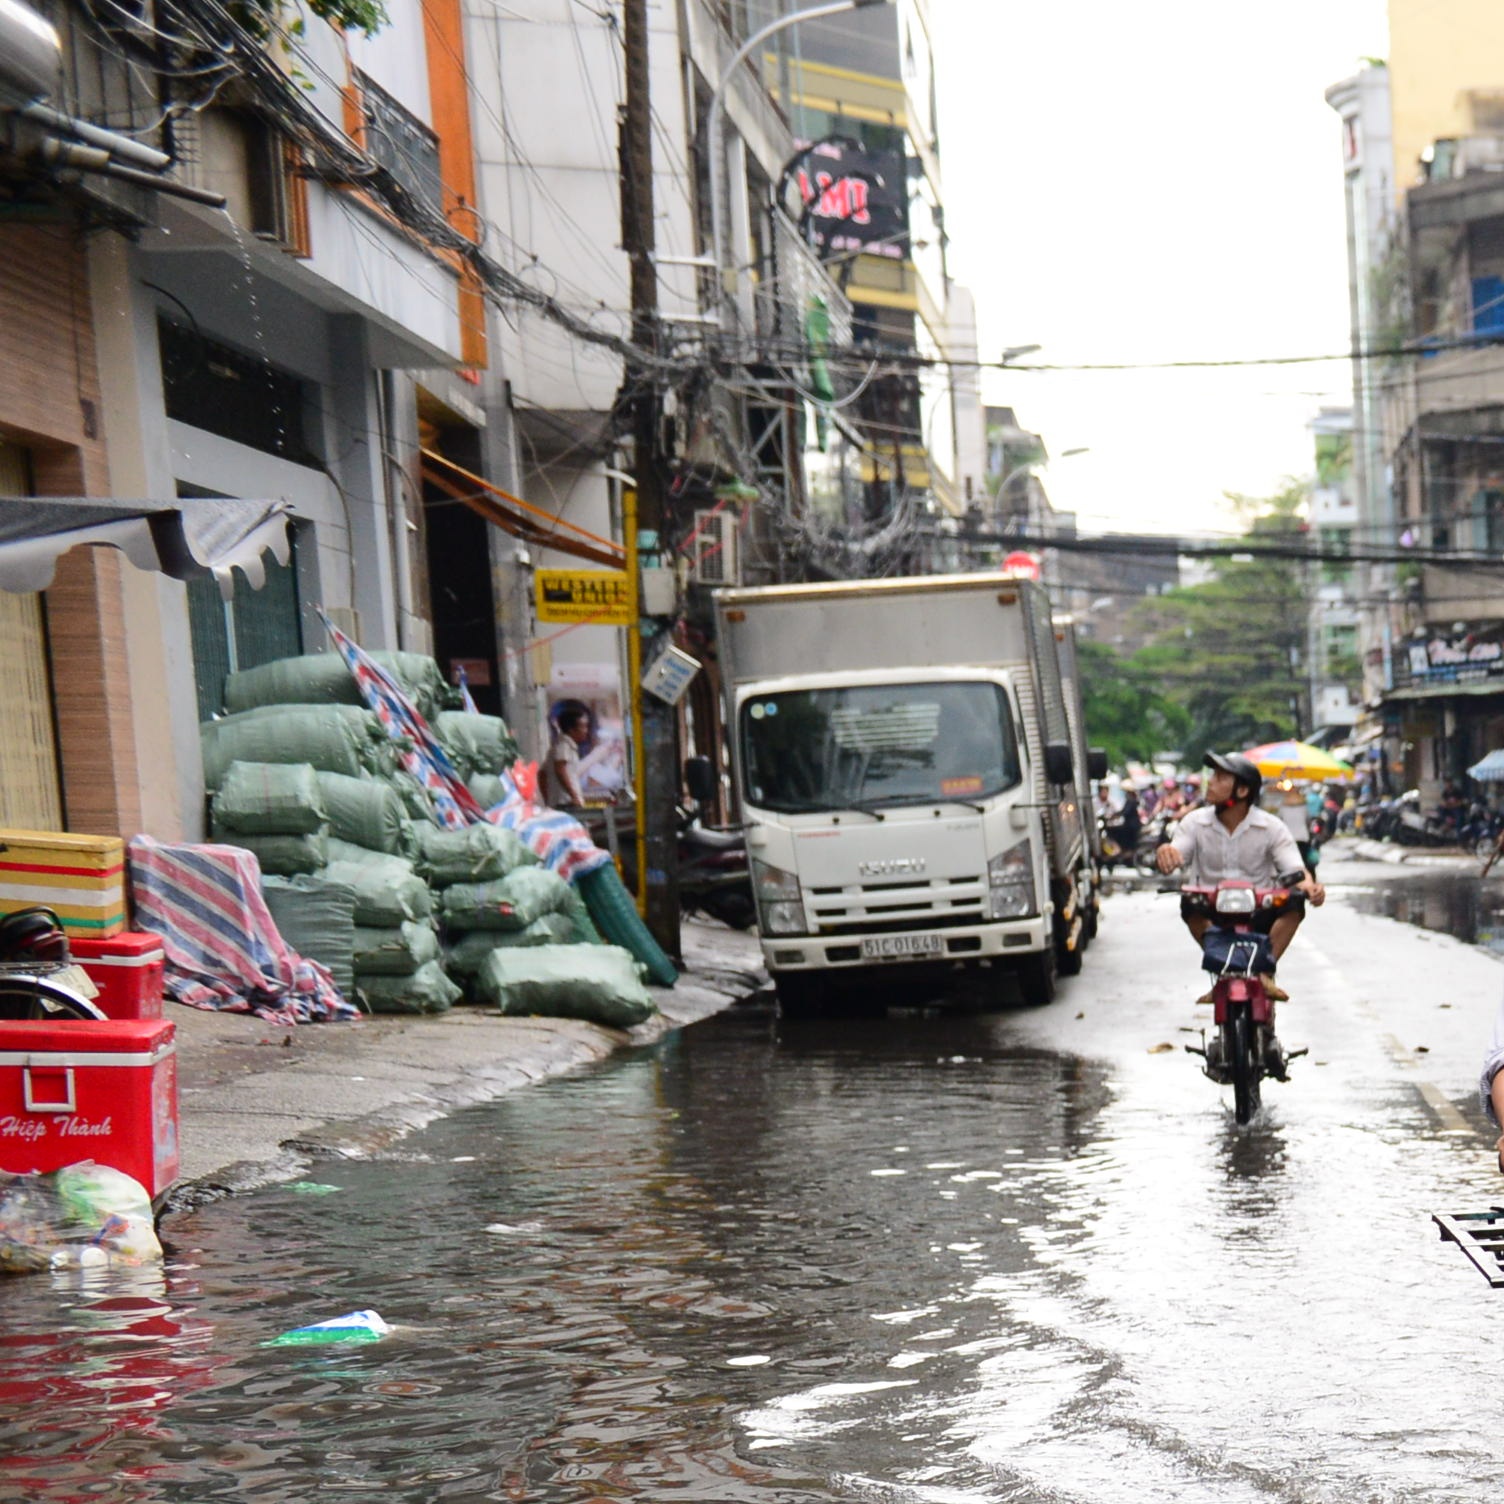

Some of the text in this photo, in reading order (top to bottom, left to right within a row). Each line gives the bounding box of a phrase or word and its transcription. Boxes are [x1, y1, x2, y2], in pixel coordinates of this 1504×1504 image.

[858, 857, 926, 877] ISUZU
[0, 1115, 112, 1142] Hiệp Thành
